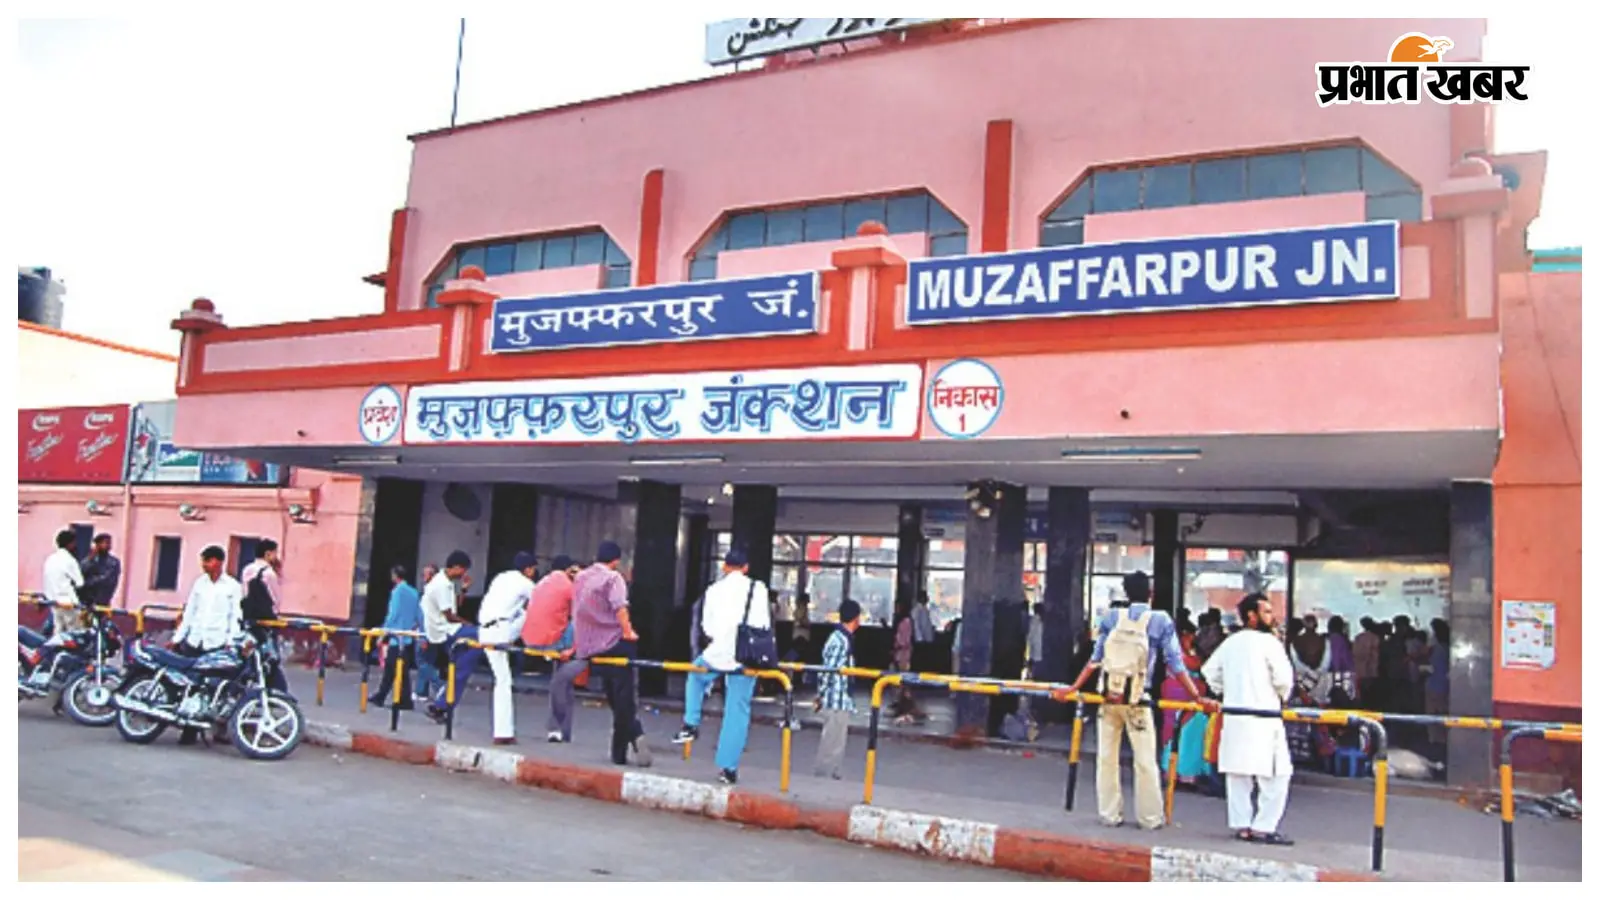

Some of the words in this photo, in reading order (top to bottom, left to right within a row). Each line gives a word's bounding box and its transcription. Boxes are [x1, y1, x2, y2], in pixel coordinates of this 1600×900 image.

[916, 244, 1279, 311] MUZAFFARPUR
[1295, 237, 1387, 288] JN.
[498, 294, 724, 345] मुजफ्फरपुर
[747, 279, 809, 319] जं.
[933, 378, 1001, 411] निकास
